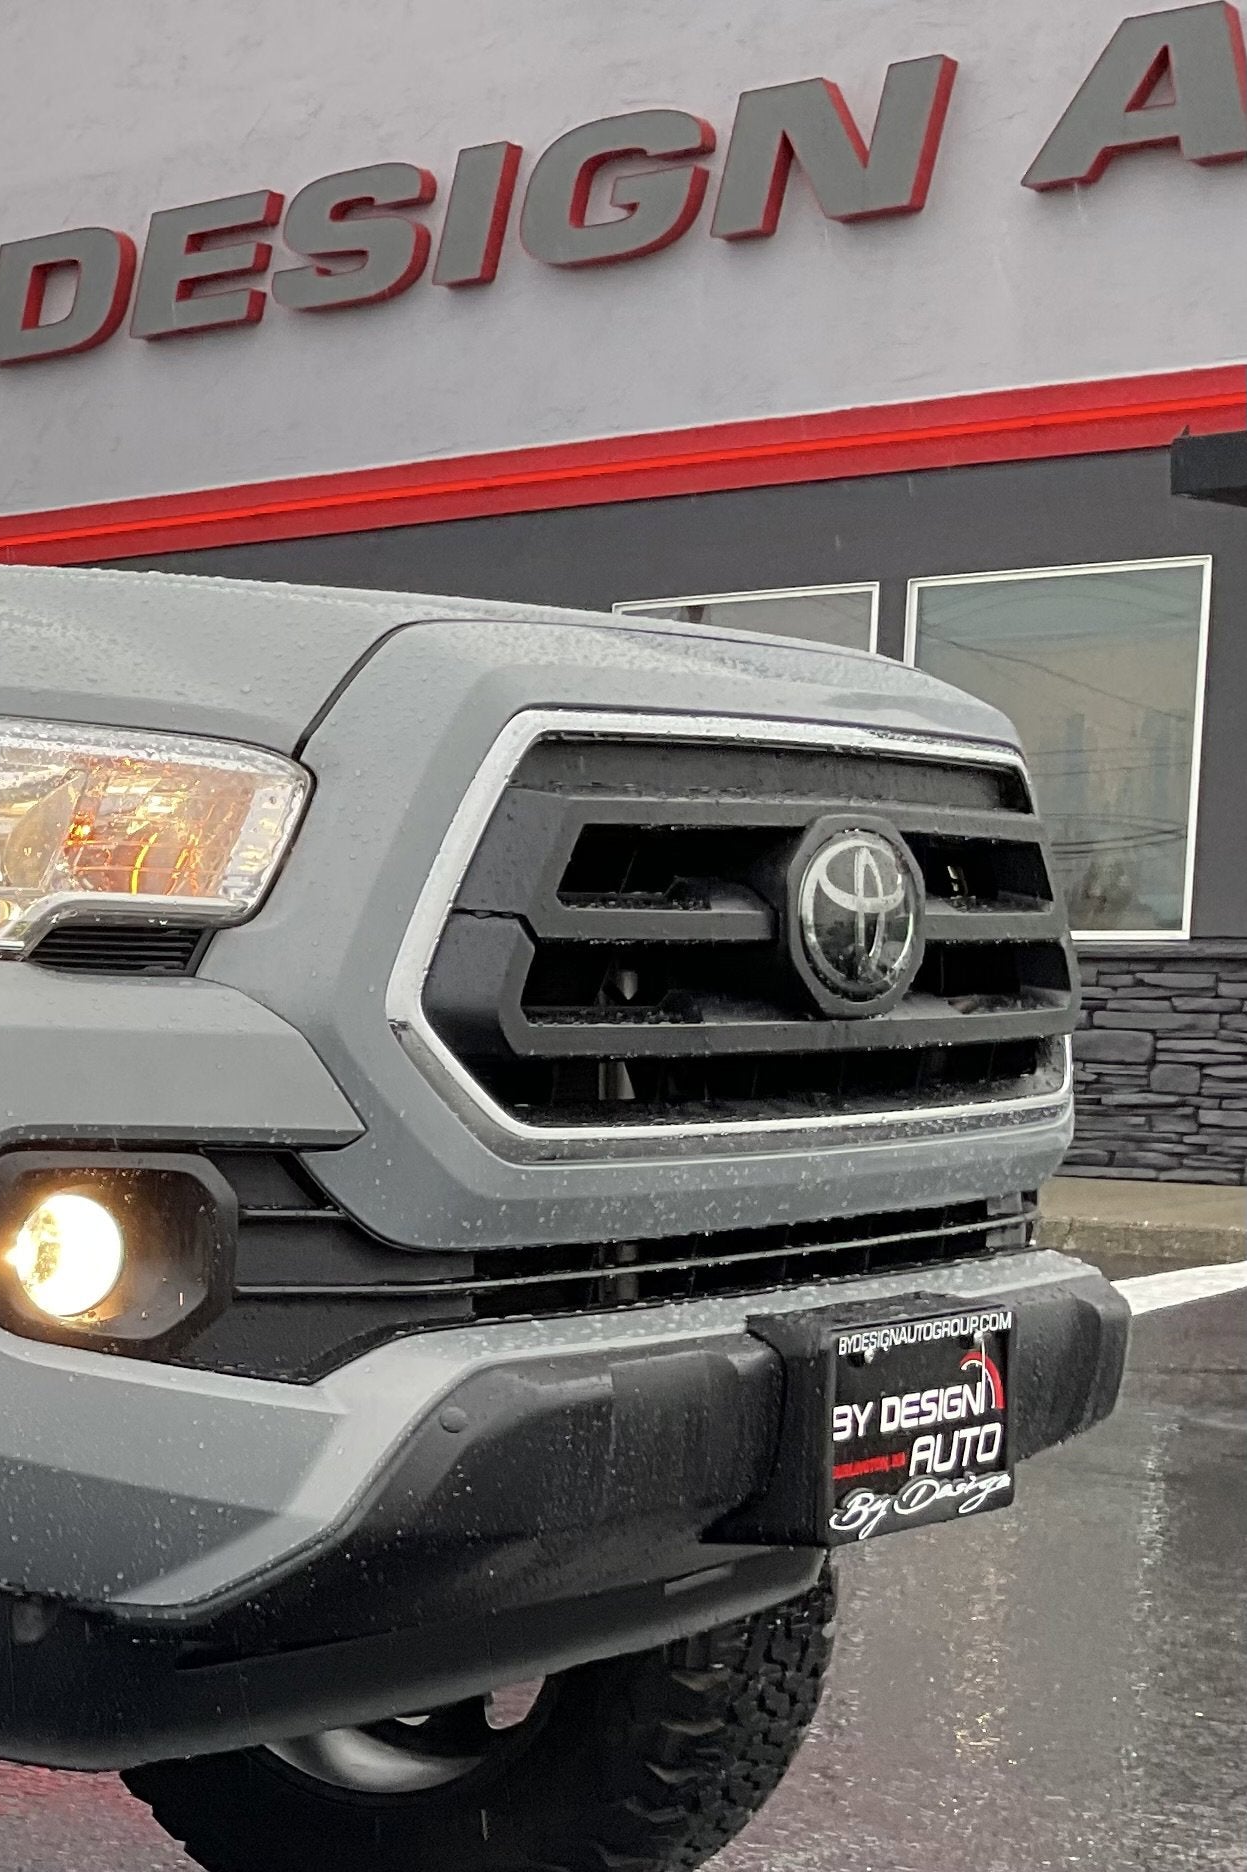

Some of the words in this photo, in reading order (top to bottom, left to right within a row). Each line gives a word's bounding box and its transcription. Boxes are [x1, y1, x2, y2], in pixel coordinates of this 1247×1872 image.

[838, 1311, 1012, 1356] BYDESIGNAUTOGROUP.COM
[833, 1401, 874, 1441] BY
[880, 1383, 985, 1433] DESIGN
[909, 1422, 1002, 1477] AUTO
[829, 1493, 891, 1540] By
